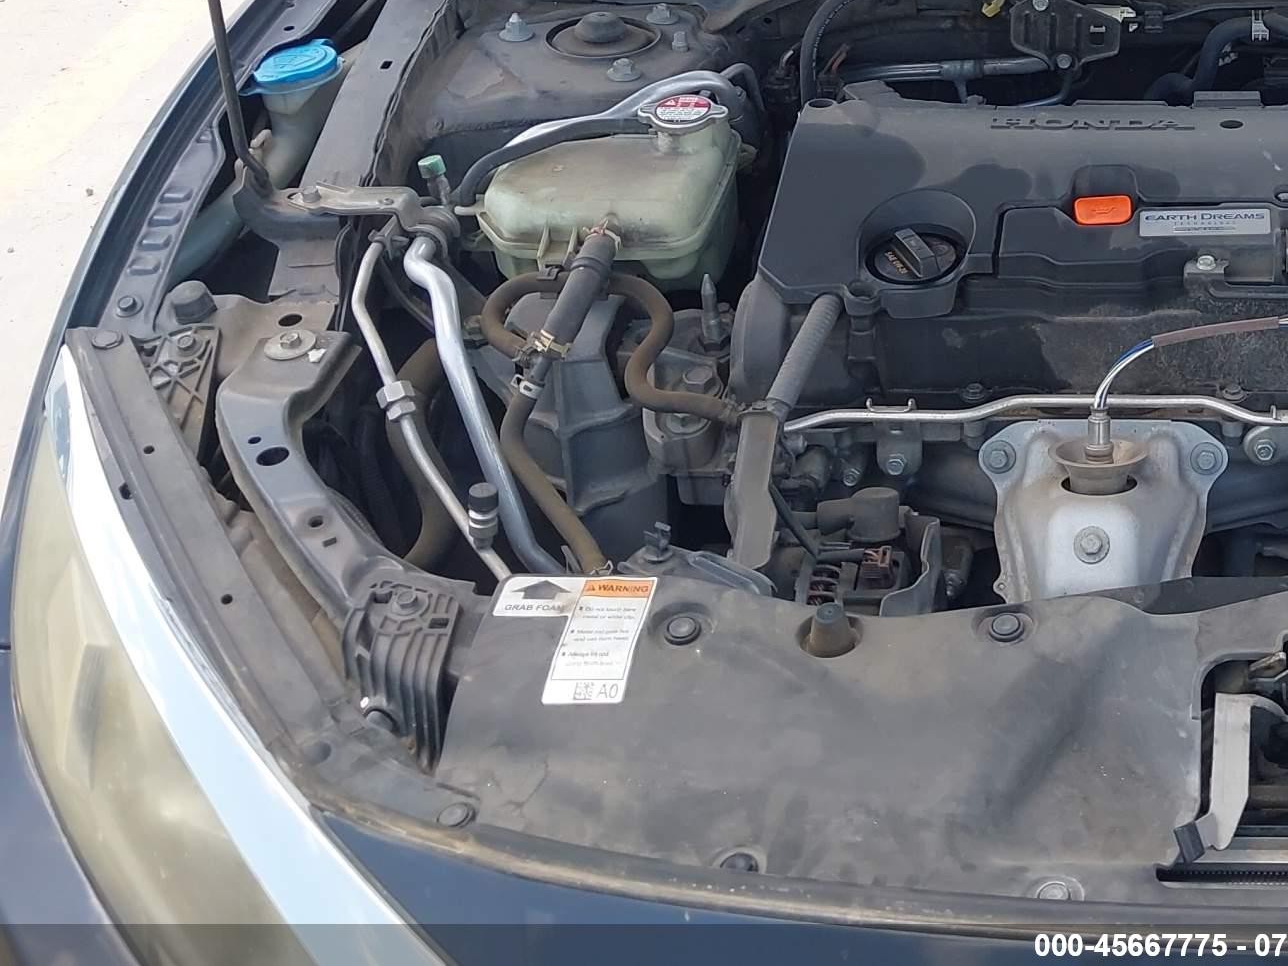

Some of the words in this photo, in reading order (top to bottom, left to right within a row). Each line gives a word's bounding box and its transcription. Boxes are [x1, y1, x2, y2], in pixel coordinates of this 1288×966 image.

[991, 116, 1196, 131] HONDA
[1144, 214, 1197, 222] EARTH
[1200, 212, 1265, 220] DREAMS
[598, 584, 649, 592] WARNING
[597, 683, 619, 699] A0
